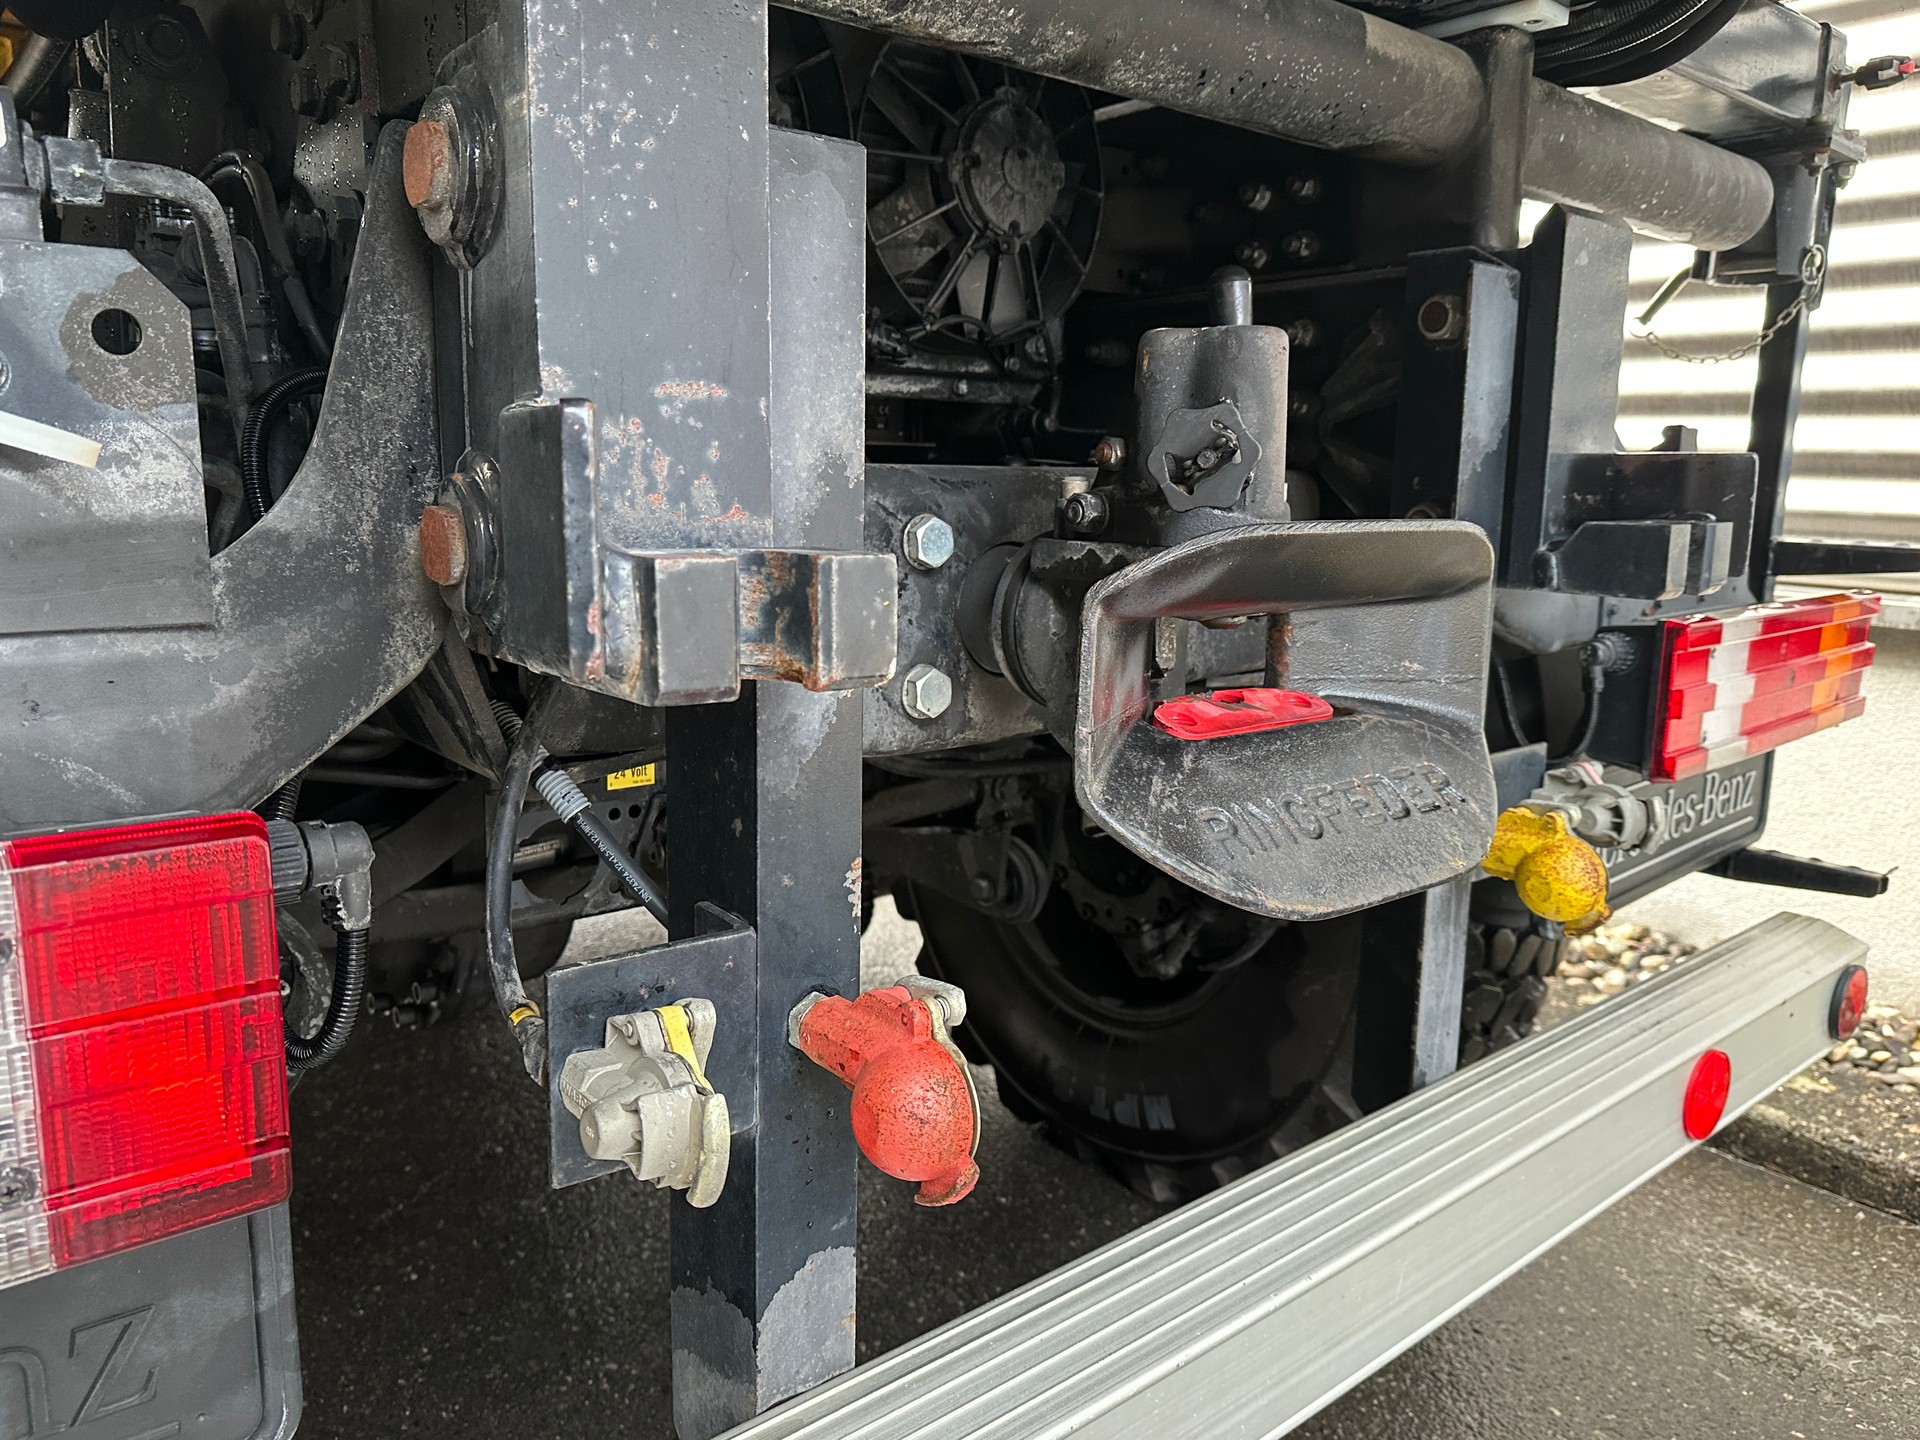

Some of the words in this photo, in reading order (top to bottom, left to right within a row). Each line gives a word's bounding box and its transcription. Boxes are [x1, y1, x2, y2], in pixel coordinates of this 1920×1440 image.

[631, 765, 648, 778] Volt
[1198, 761, 1466, 860] RINGFEDER
[638, 888, 652, 903] DIN
[1089, 1085, 1177, 1131] MPT
